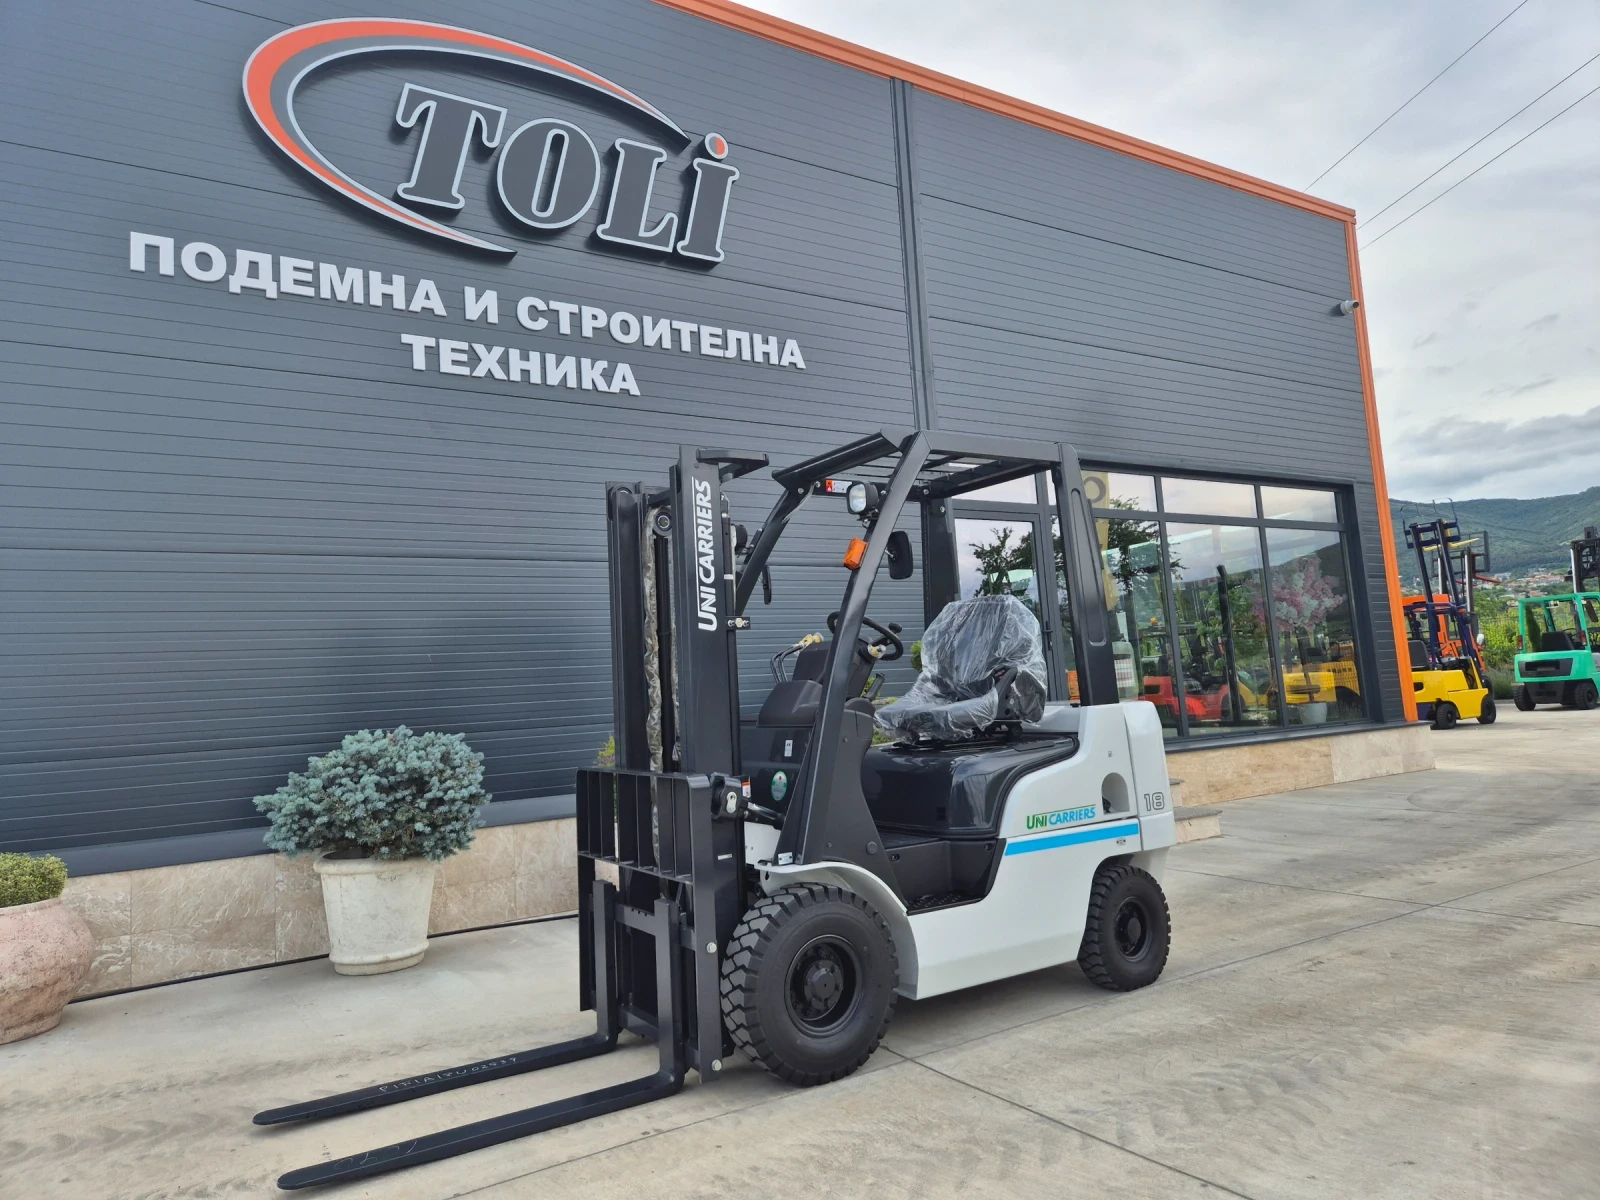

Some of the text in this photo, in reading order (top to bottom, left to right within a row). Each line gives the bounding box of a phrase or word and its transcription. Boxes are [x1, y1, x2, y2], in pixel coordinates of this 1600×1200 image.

[130, 231, 807, 370] ПОДЕМНА И СТРОИТЕЛНА
[400, 333, 641, 397] ТЕХНИКА
[1143, 792, 1165, 812] 18
